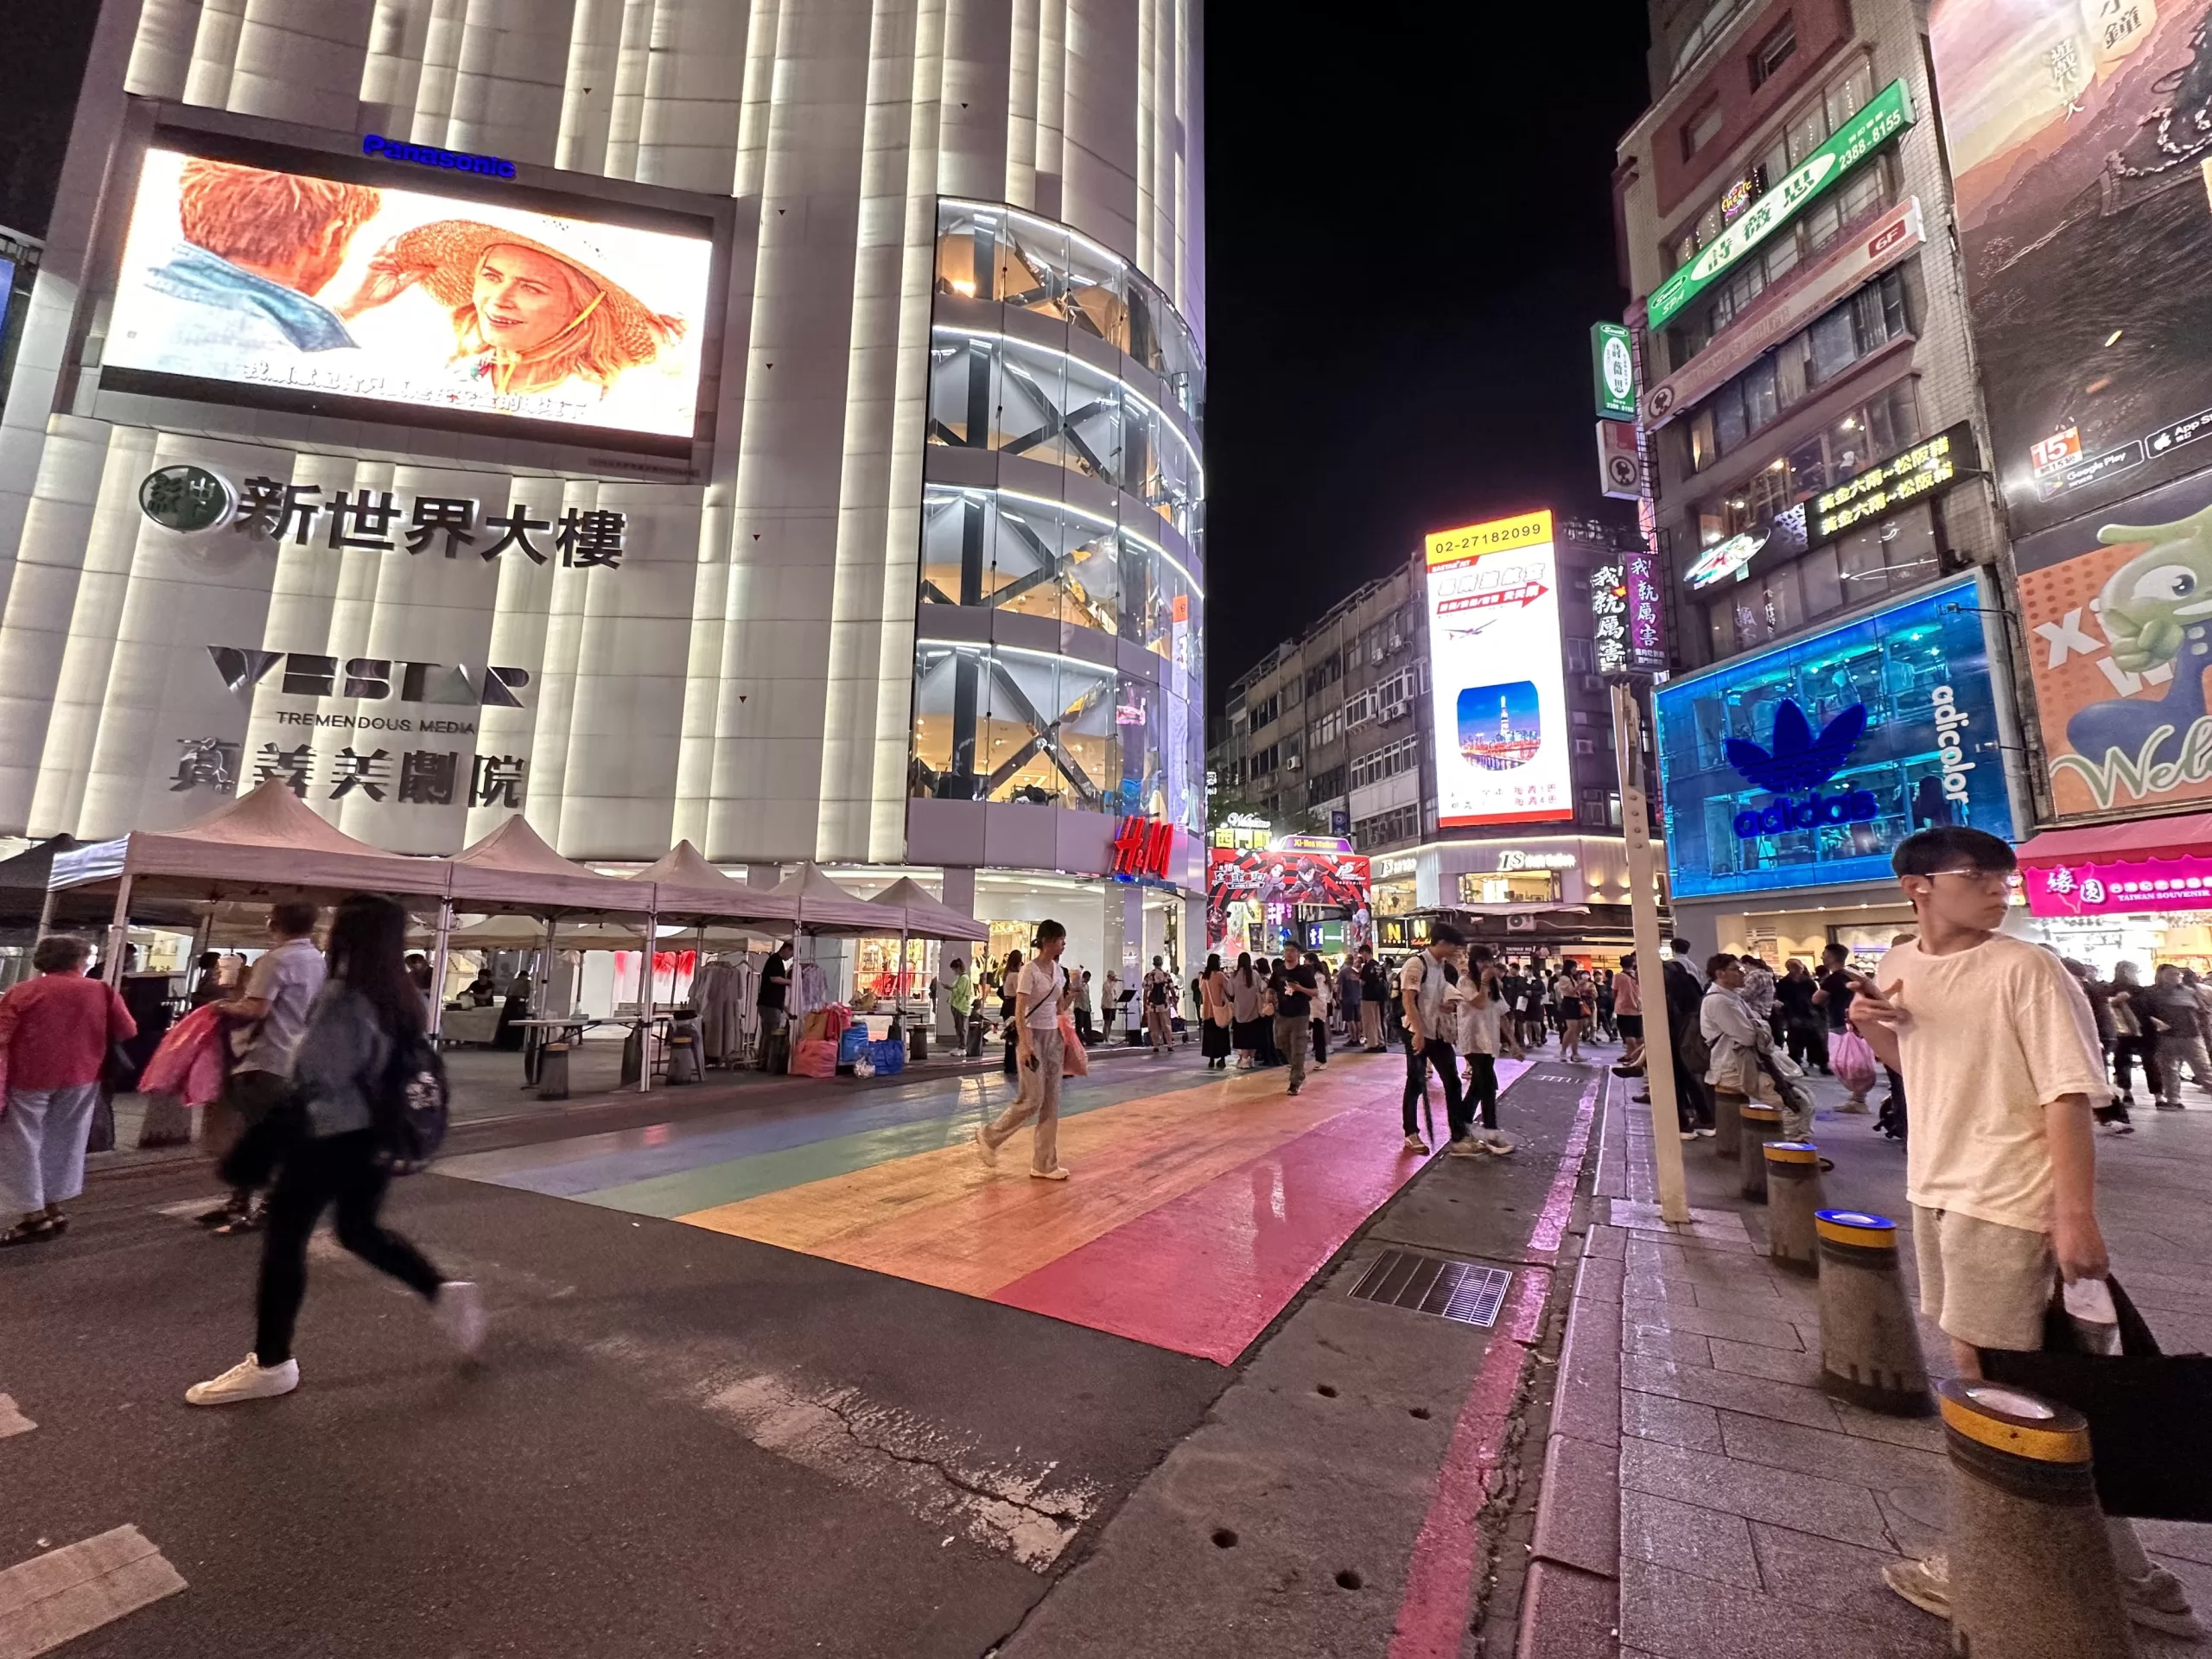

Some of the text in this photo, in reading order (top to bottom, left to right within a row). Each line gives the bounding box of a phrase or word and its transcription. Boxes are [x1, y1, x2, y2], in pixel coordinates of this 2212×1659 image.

[363, 134, 516, 179] Panasonic
[1839, 109, 1901, 171] 2388-8155
[1875, 226, 1899, 251] 6F
[1662, 289, 1685, 315] SPA
[2174, 421, 2201, 436] App
[2066, 451, 2126, 481] Google Play
[233, 476, 626, 571] 新世界大樓
[1435, 524, 1541, 554] 02-27182099
[276, 710, 476, 735] TREMENDOUS MEDIA
[1931, 685, 1976, 804] adicolor
[169, 736, 525, 809] 真善美劇院
[1732, 790, 1878, 839] adidas
[1114, 815, 1174, 880] H&M
[2118, 890, 2211, 902] TAIWAN SOUVENIR
